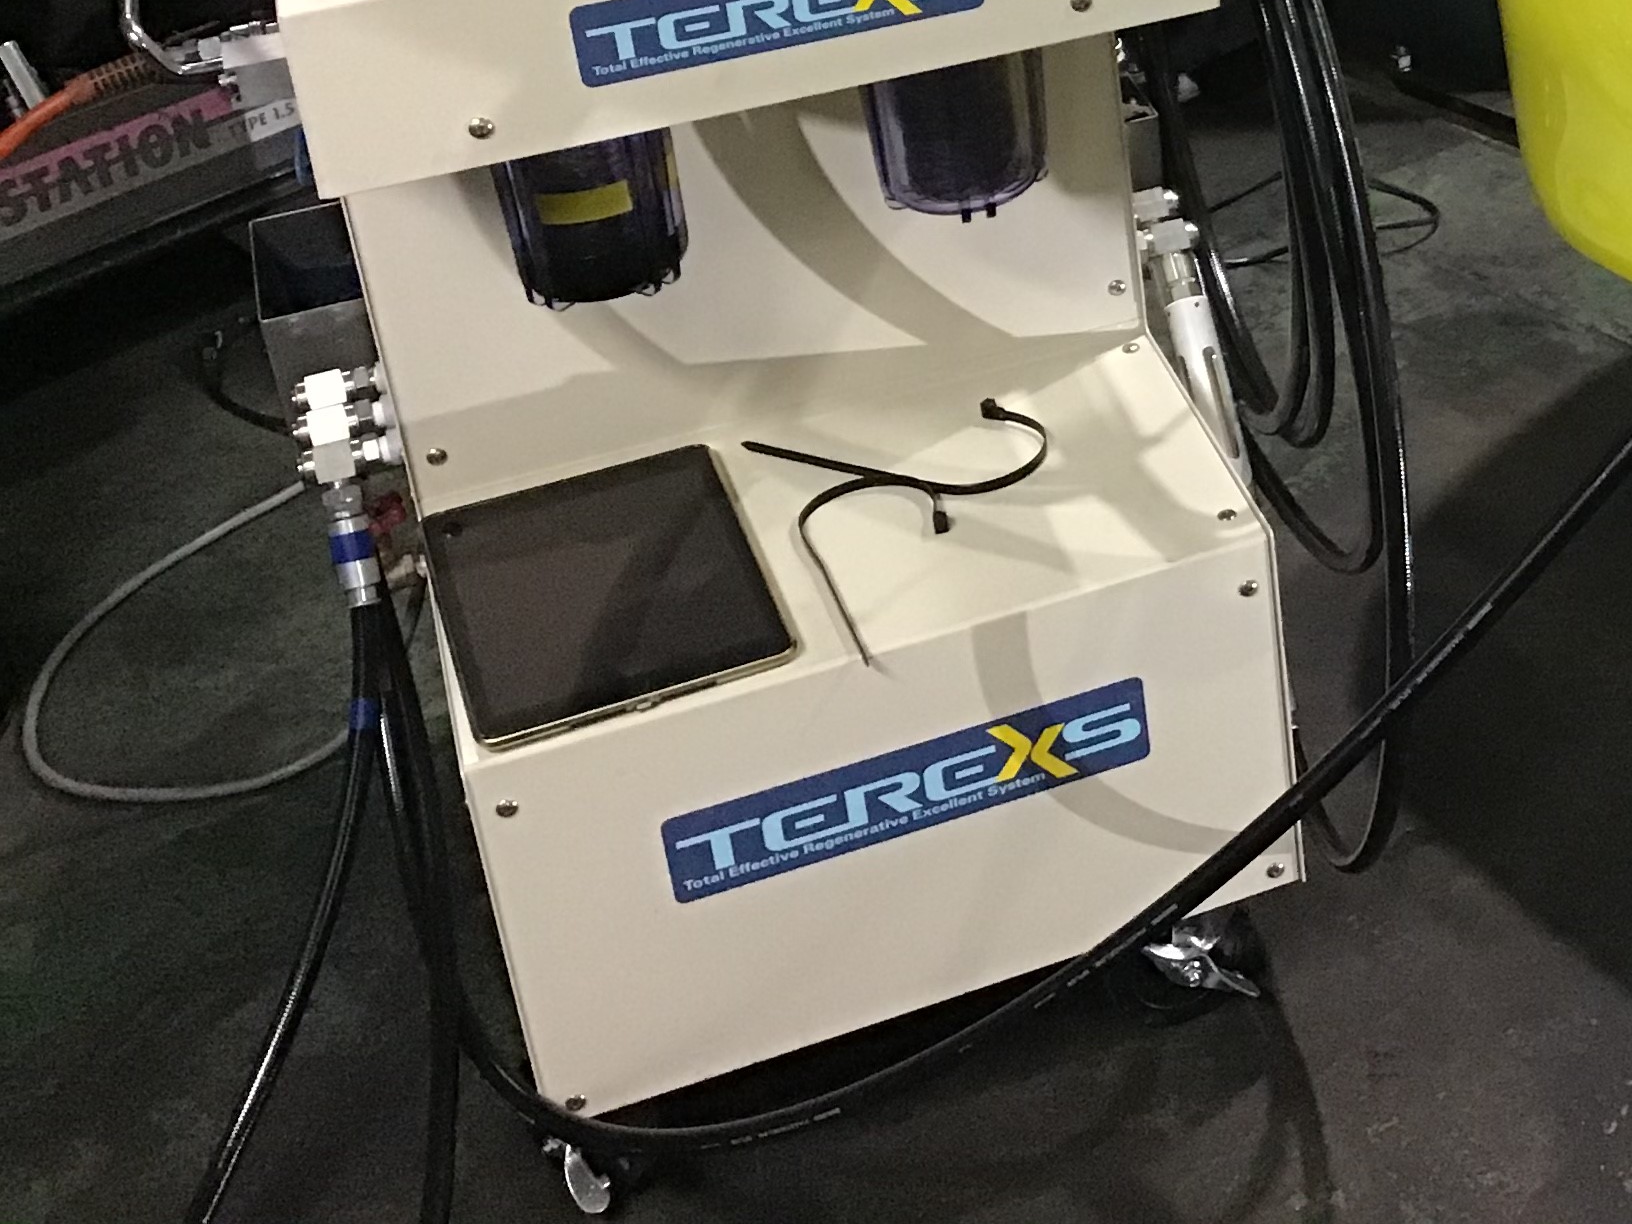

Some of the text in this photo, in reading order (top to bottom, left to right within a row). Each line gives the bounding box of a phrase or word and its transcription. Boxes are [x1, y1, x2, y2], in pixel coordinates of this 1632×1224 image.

[591, 7, 896, 77] Total Effective Regenerative Excellent System
[675, 703, 1141, 870] TEREXS
[682, 772, 1047, 893] Total Effective Regenerative Excellent System
